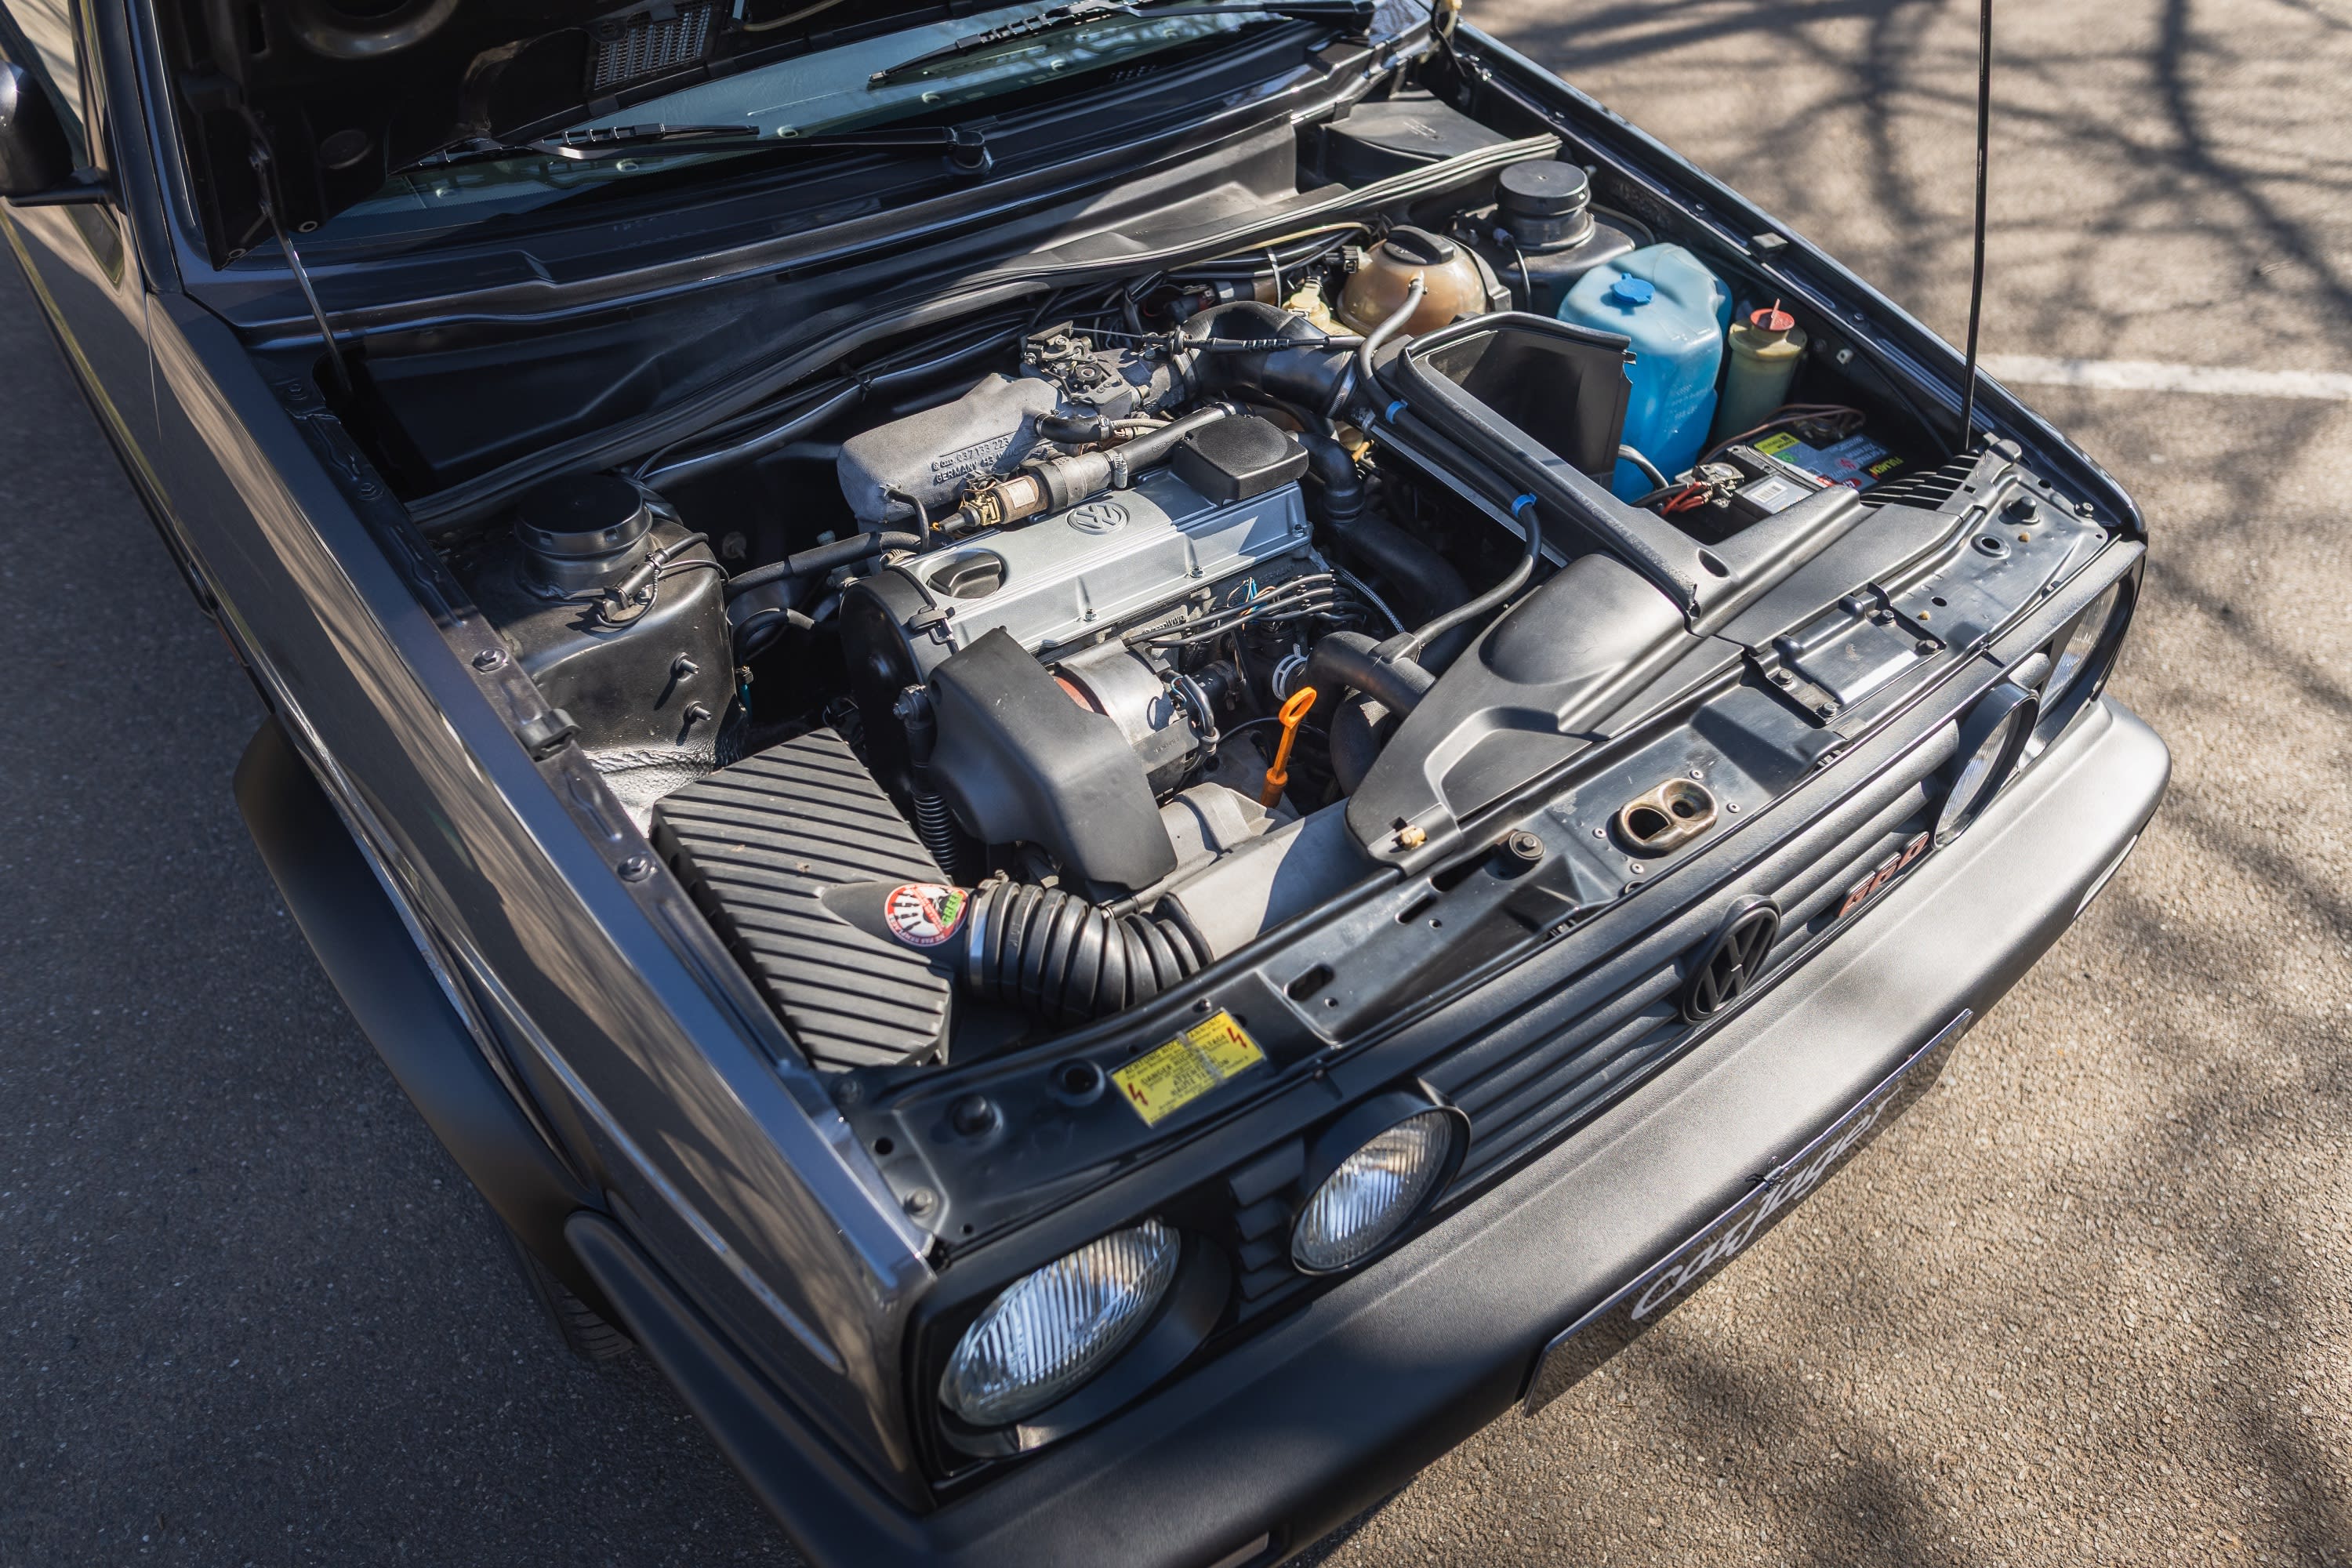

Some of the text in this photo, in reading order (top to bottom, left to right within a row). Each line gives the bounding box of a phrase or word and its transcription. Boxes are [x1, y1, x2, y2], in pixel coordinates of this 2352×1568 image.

[975, 443, 991, 456] 133
[992, 437, 1010, 451] 223
[936, 459, 978, 483] GERMANY
[1869, 456, 1904, 476] FULMEN
[1688, 905, 1780, 1022] VW
[1140, 1062, 1173, 1085] DANGER
[1170, 1076, 1196, 1096] HAUTE
[1196, 1057, 1230, 1080] TEON
